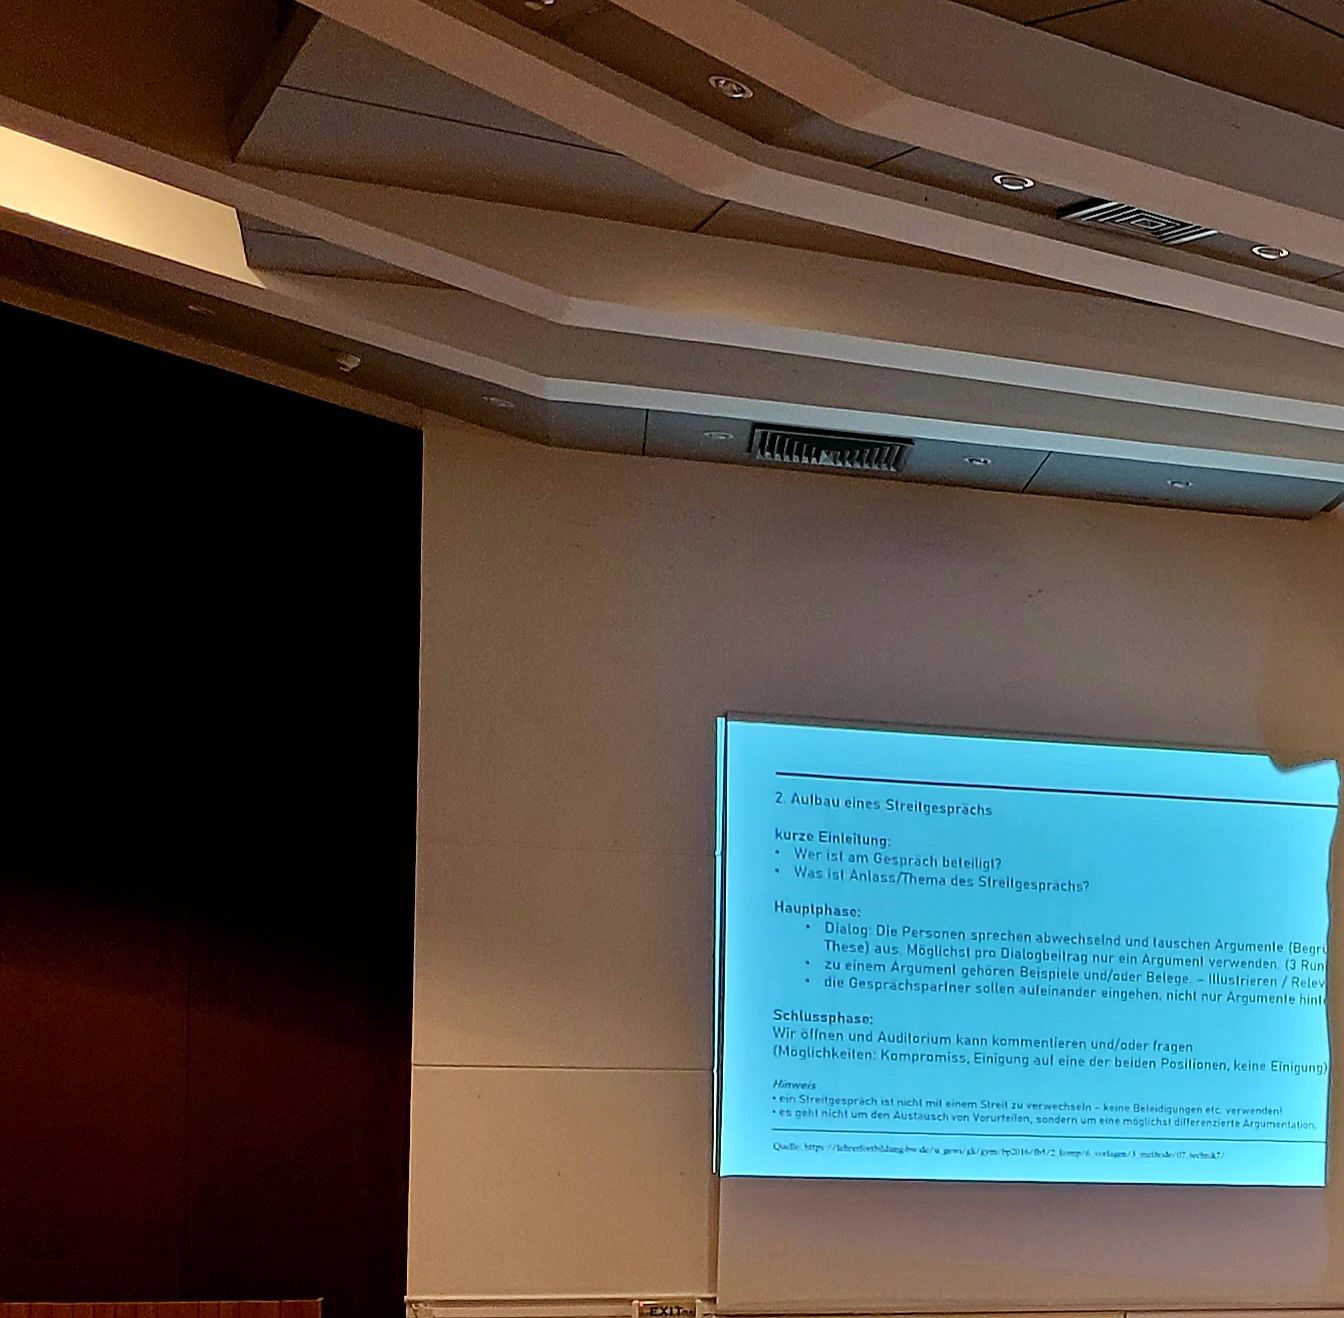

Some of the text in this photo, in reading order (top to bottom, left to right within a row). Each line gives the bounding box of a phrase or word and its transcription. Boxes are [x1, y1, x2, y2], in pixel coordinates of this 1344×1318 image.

[790, 792, 840, 807] Aufbau
[844, 796, 881, 809] eines
[774, 828, 814, 842] kurze
[794, 847, 822, 860] Wer
[826, 849, 845, 862] ist
[848, 853, 869, 863] am
[942, 855, 1002, 873] beteiligt?
[794, 866, 823, 879] Was
[827, 868, 844, 880] ist
[849, 869, 946, 886] Anlass/Thema
[950, 874, 974, 887] des
[774, 901, 862, 918] Hauptphase:
[773, 1008, 874, 1025] Schlussphase:
[772, 1026, 796, 1039] Wir
[849, 1030, 874, 1042] und
[877, 1030, 952, 1045] Auditorium
[956, 1033, 988, 1046] kann
[992, 1034, 1087, 1049] kommentieren
[1090, 1037, 1149, 1053] und/oder
[1152, 1039, 1193, 1055] fragen
[880, 1048, 970, 1065] Kompromiss,
[974, 1051, 1029, 1068] Einigung
[1033, 1053, 1054, 1066] auf
[1058, 1054, 1085, 1067] eine
[1089, 1055, 1110, 1067] der
[1114, 1055, 1156, 1069] beiden
[1161, 1057, 1230, 1073] Positionen,
[1233, 1059, 1266, 1072] keine
[1270, 1060, 1328, 1076] Einigung)
[650, 1306, 683, 1317] EXIT
